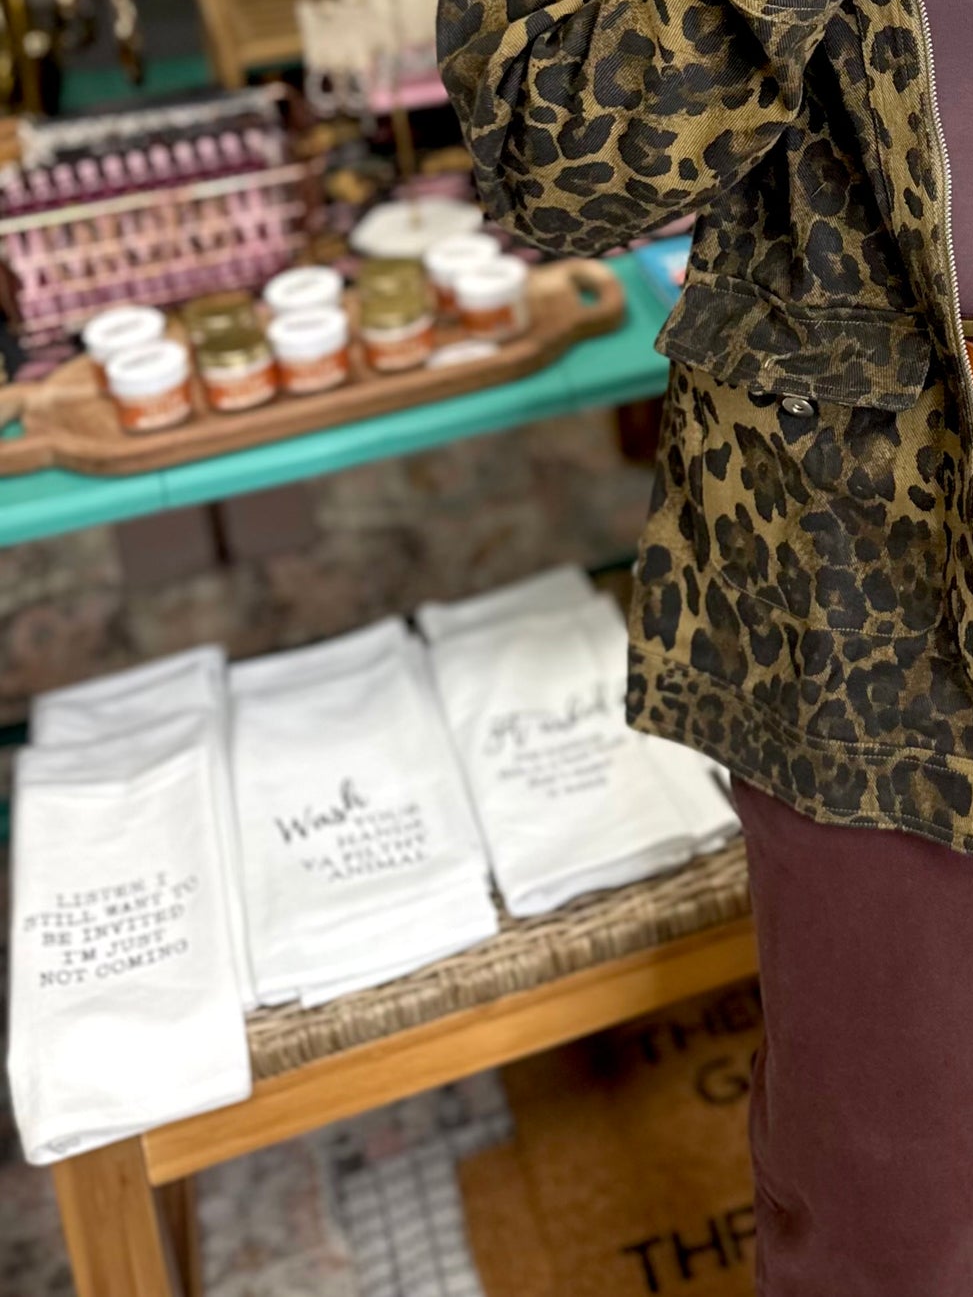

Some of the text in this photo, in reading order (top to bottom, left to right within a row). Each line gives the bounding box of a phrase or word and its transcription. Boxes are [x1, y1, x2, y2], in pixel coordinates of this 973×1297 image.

[274, 776, 370, 844] Wash
[24, 875, 199, 933] STILL WANT TO
[56, 878, 145, 909] LISTEN
[41, 903, 185, 947] BE INVITED
[63, 928, 166, 966] I'M JUST
[40, 938, 189, 989] NOT COMING
